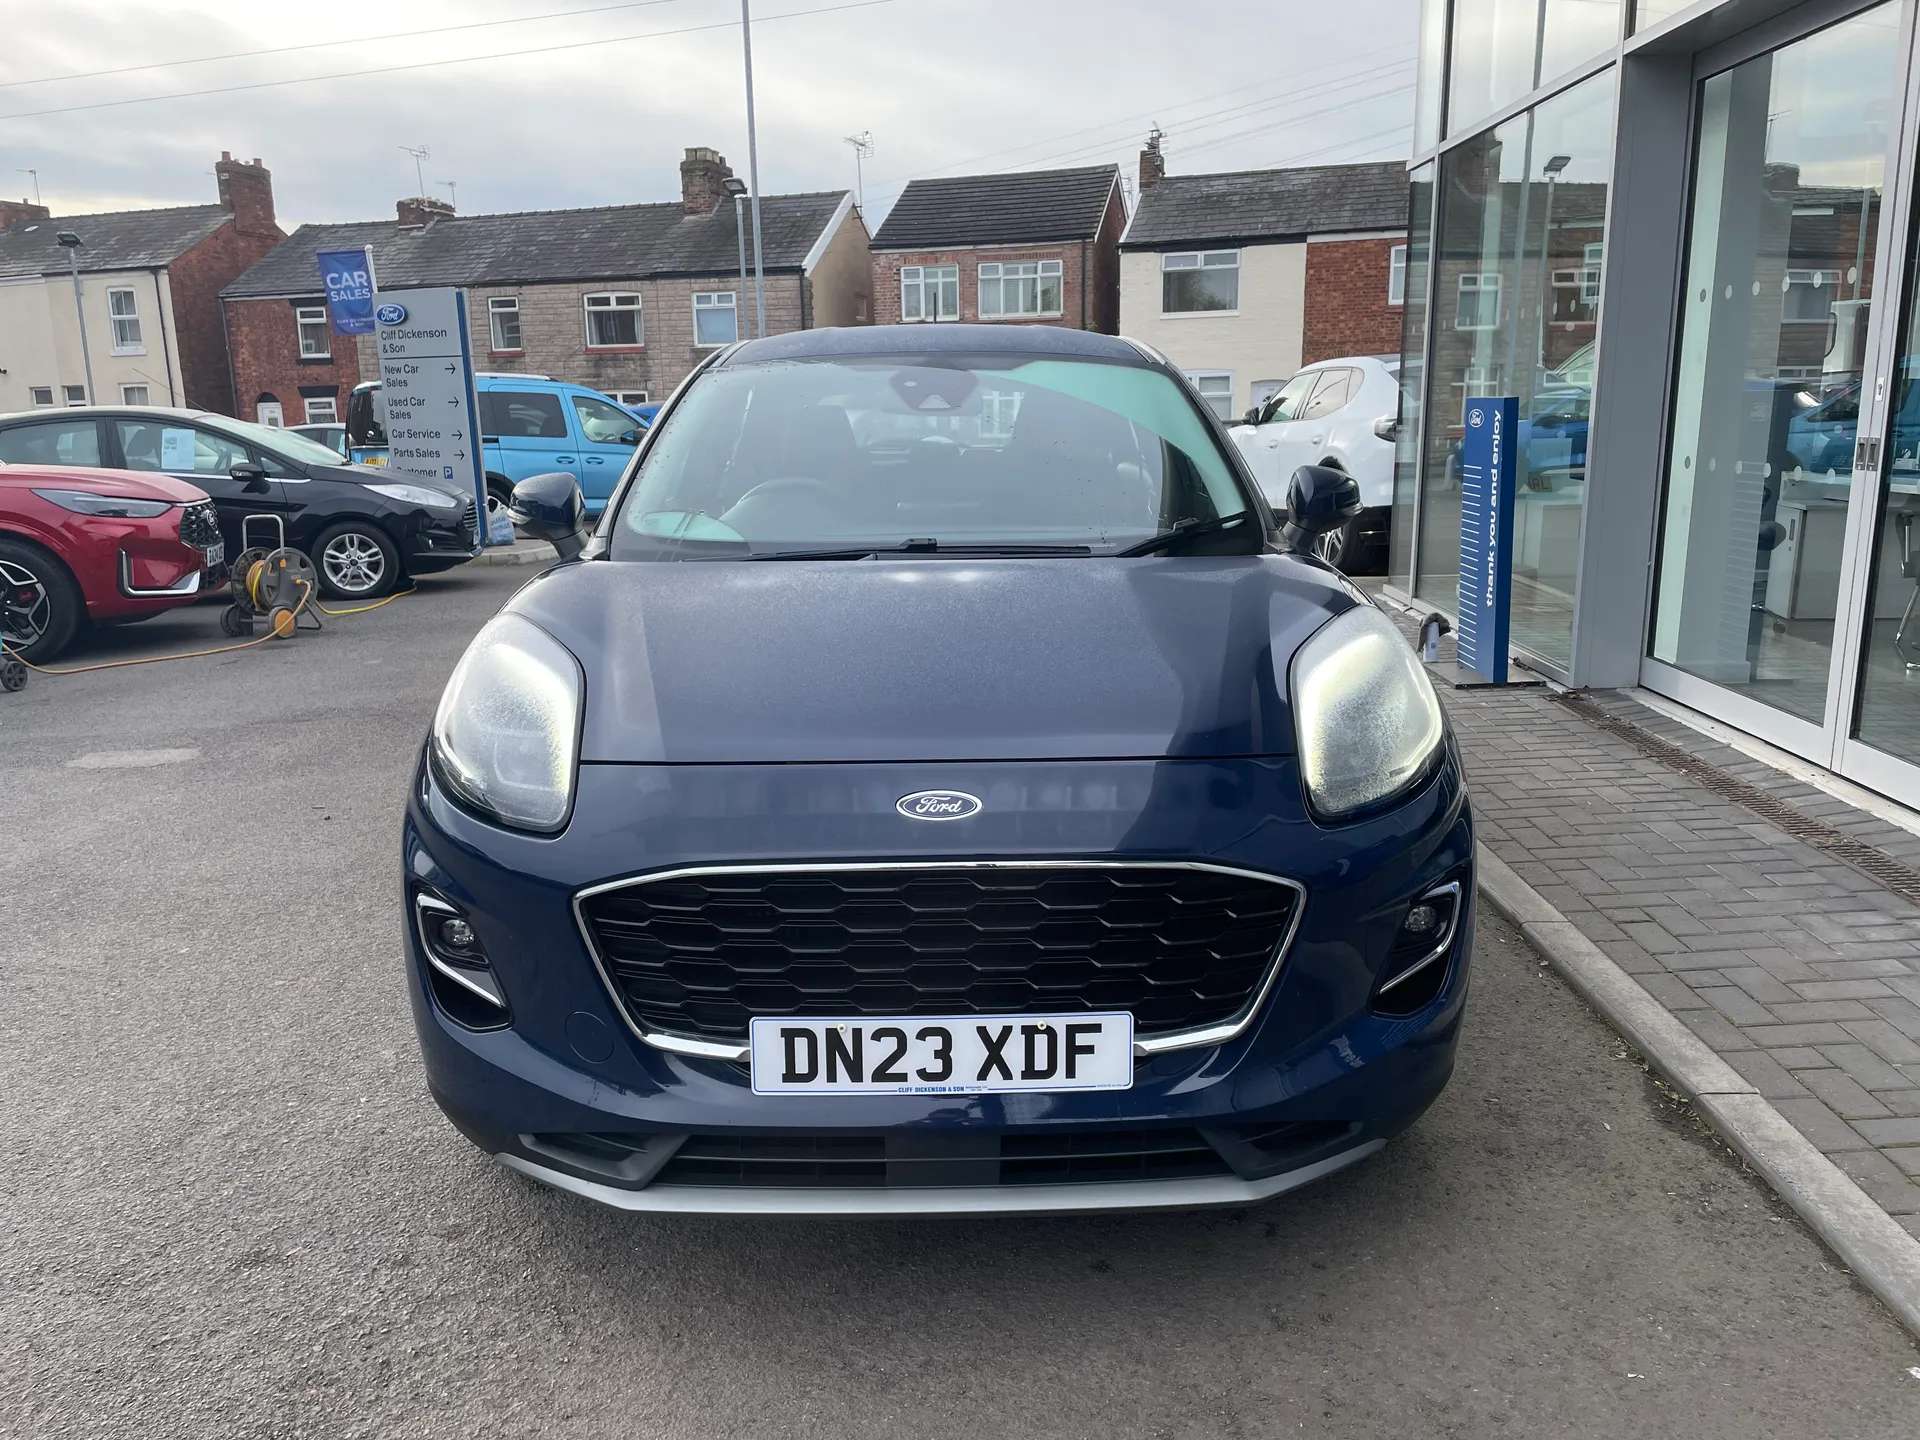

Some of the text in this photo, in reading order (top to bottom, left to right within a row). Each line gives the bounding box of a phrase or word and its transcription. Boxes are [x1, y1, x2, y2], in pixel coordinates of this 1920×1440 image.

[326, 271, 368, 288] CAR
[330, 288, 371, 302] SALES
[381, 307, 399, 321] Ford
[381, 329, 447, 341] Cliff Dickenson
[382, 343, 406, 353] & Son
[384, 364, 419, 374] New Car
[386, 378, 408, 387] Sales
[388, 397, 425, 407] Used Car
[390, 410, 412, 419] Sales
[391, 429, 441, 439] Car Service
[393, 448, 441, 458] Parts Sales
[1486, 551, 1495, 608] thank
[1492, 409, 1501, 465] enjoy
[915, 796, 962, 813] Ford
[780, 1023, 1102, 1083] DN23 XDF
